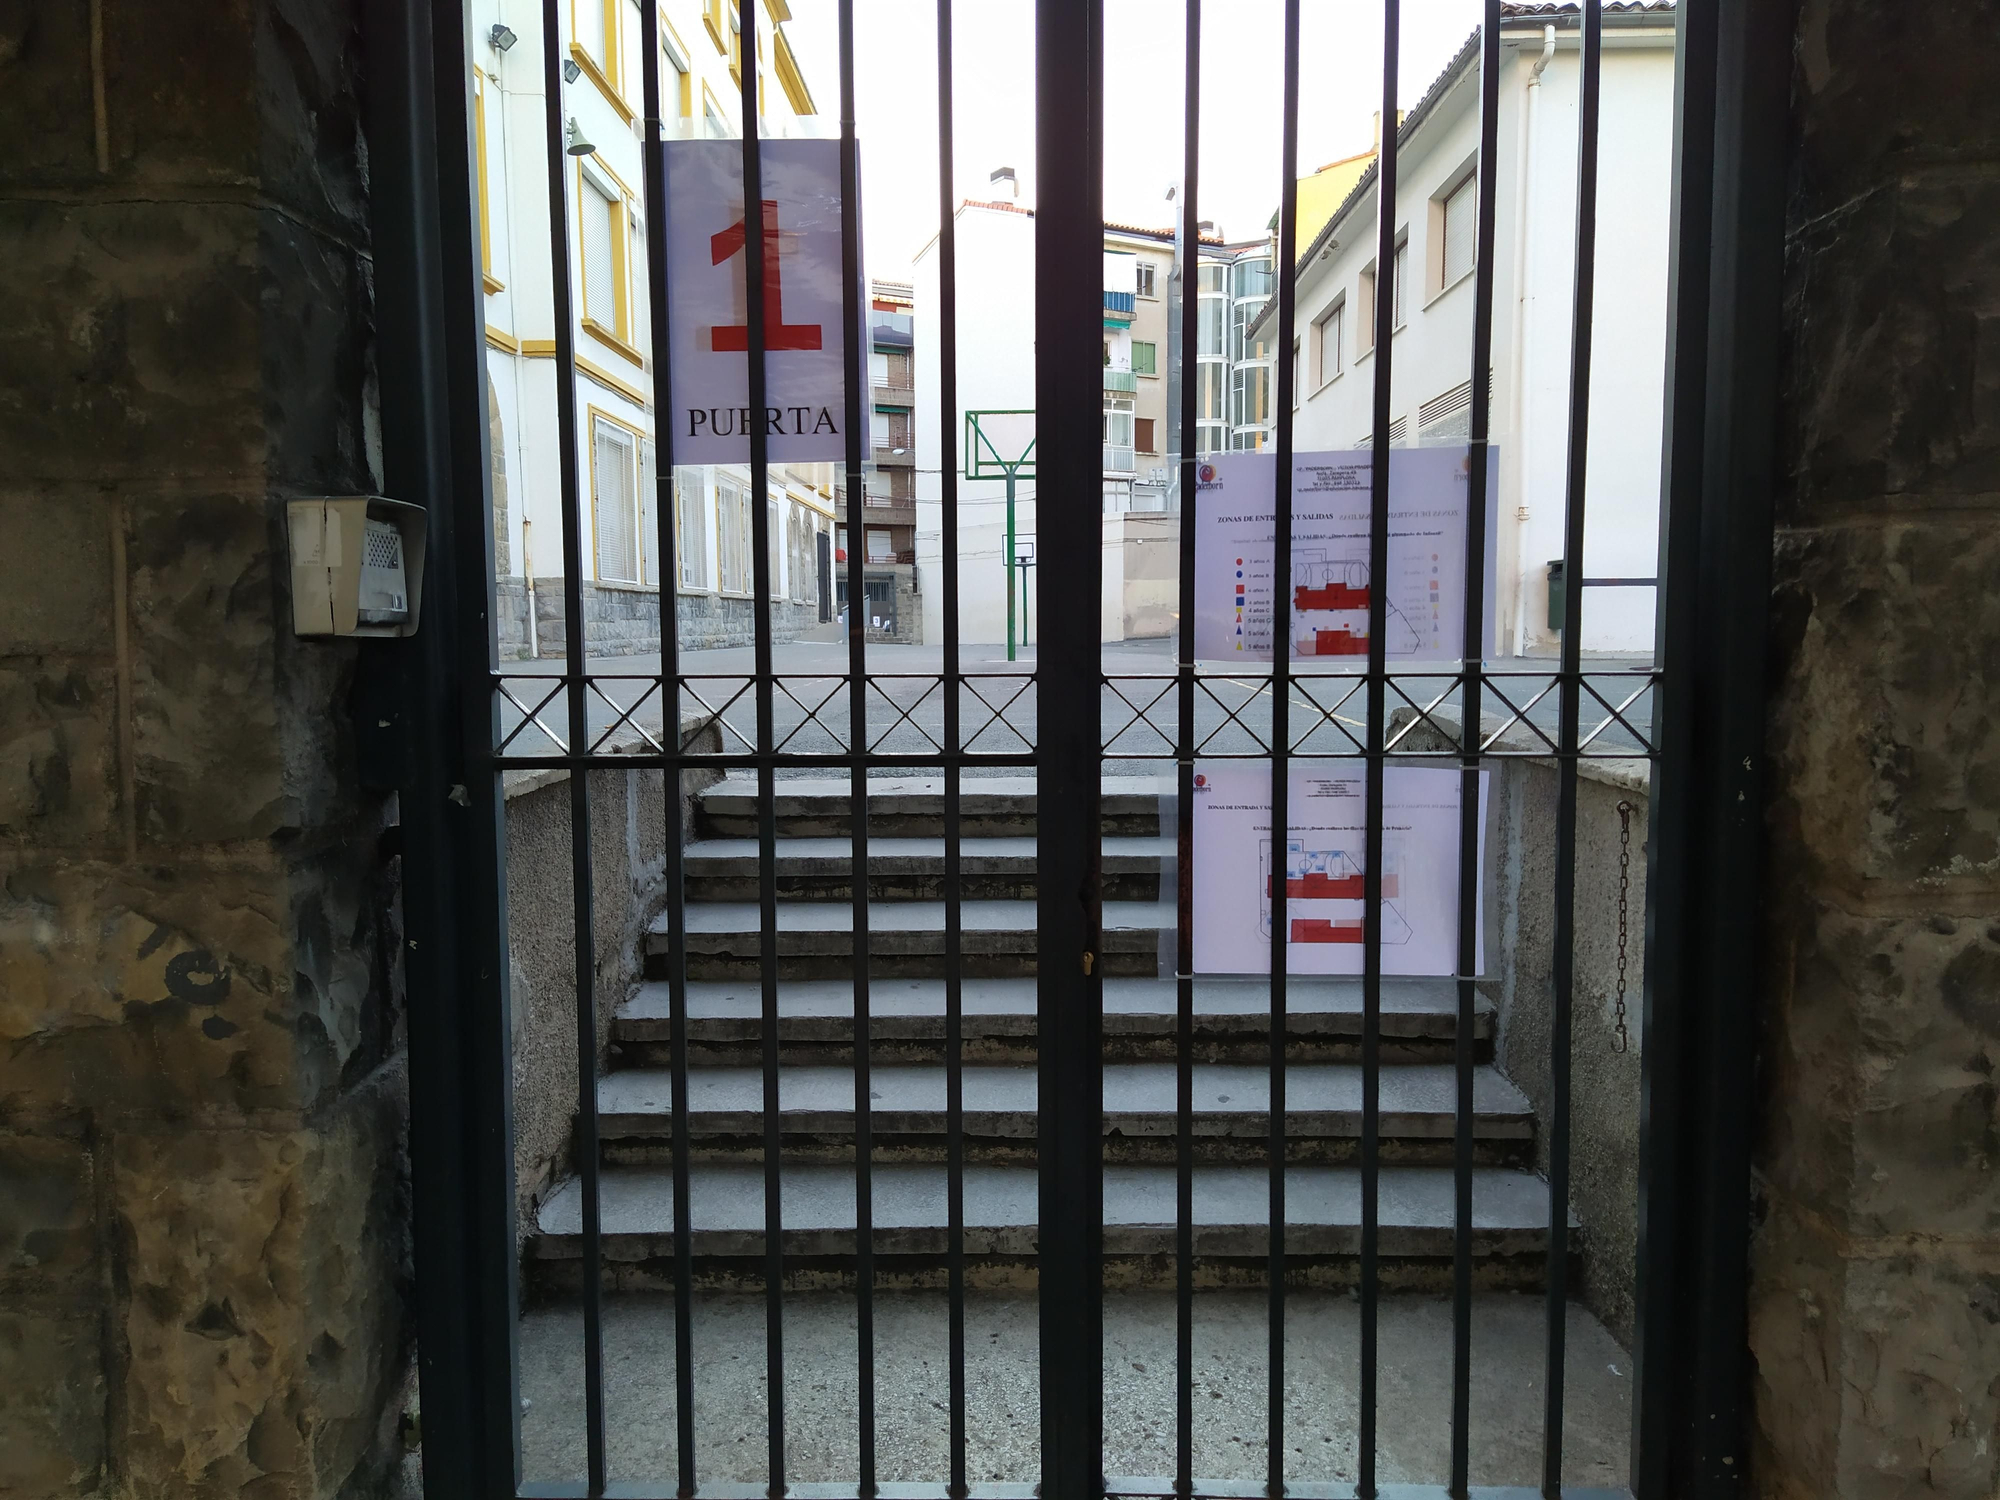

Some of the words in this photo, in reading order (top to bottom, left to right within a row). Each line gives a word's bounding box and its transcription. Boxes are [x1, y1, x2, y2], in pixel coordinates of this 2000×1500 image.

[710, 199, 822, 351] 1
[1255, 513, 1294, 522] ENTRS
[1302, 512, 1334, 521] SALIDAS
